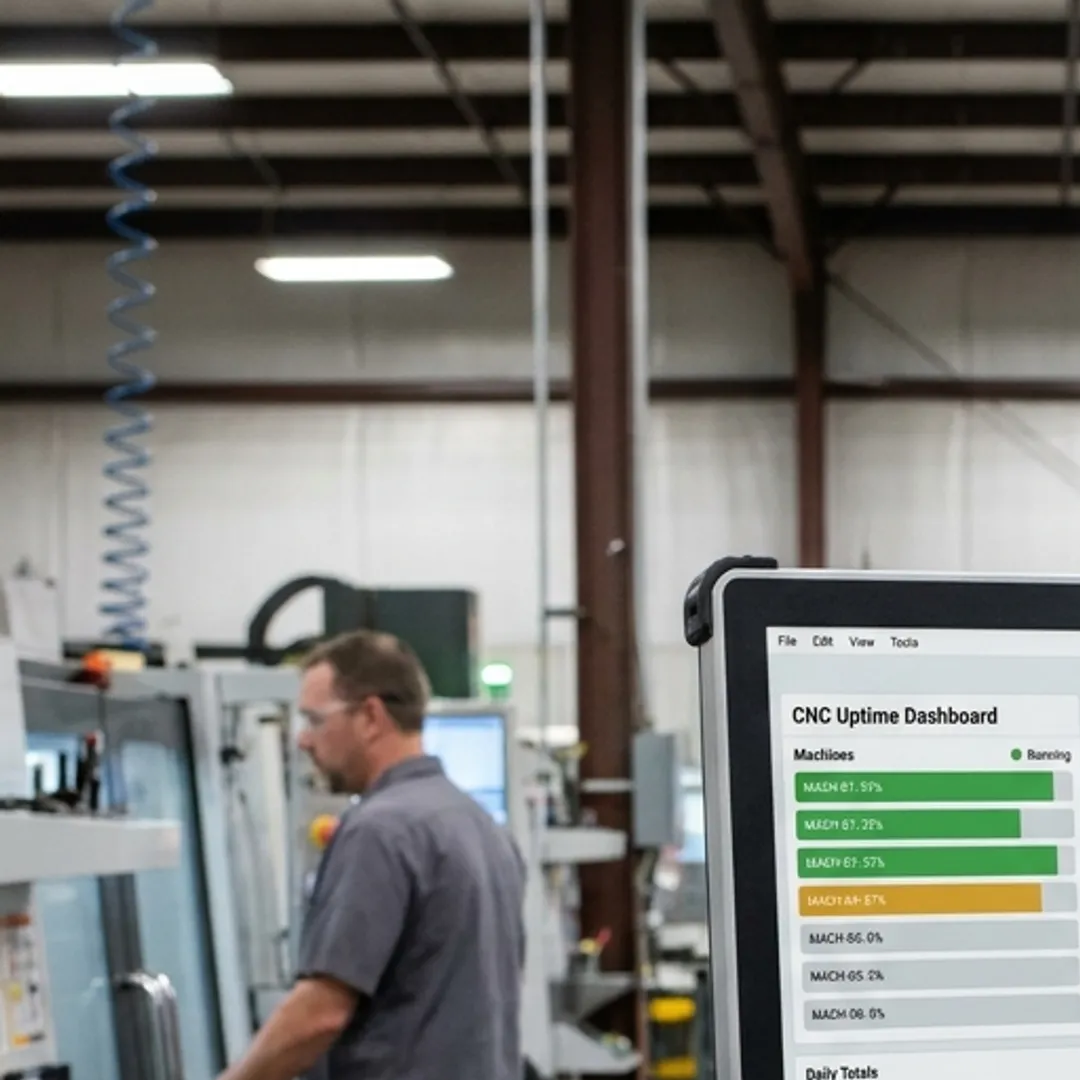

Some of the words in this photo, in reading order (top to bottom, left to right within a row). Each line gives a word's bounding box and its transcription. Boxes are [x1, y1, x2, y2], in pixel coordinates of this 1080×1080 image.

[778, 635, 797, 646] File
[793, 707, 831, 724] CNC
[837, 707, 899, 728] Uptime
[905, 707, 997, 724] Dashboard
[840, 1066, 878, 1080] Totals
